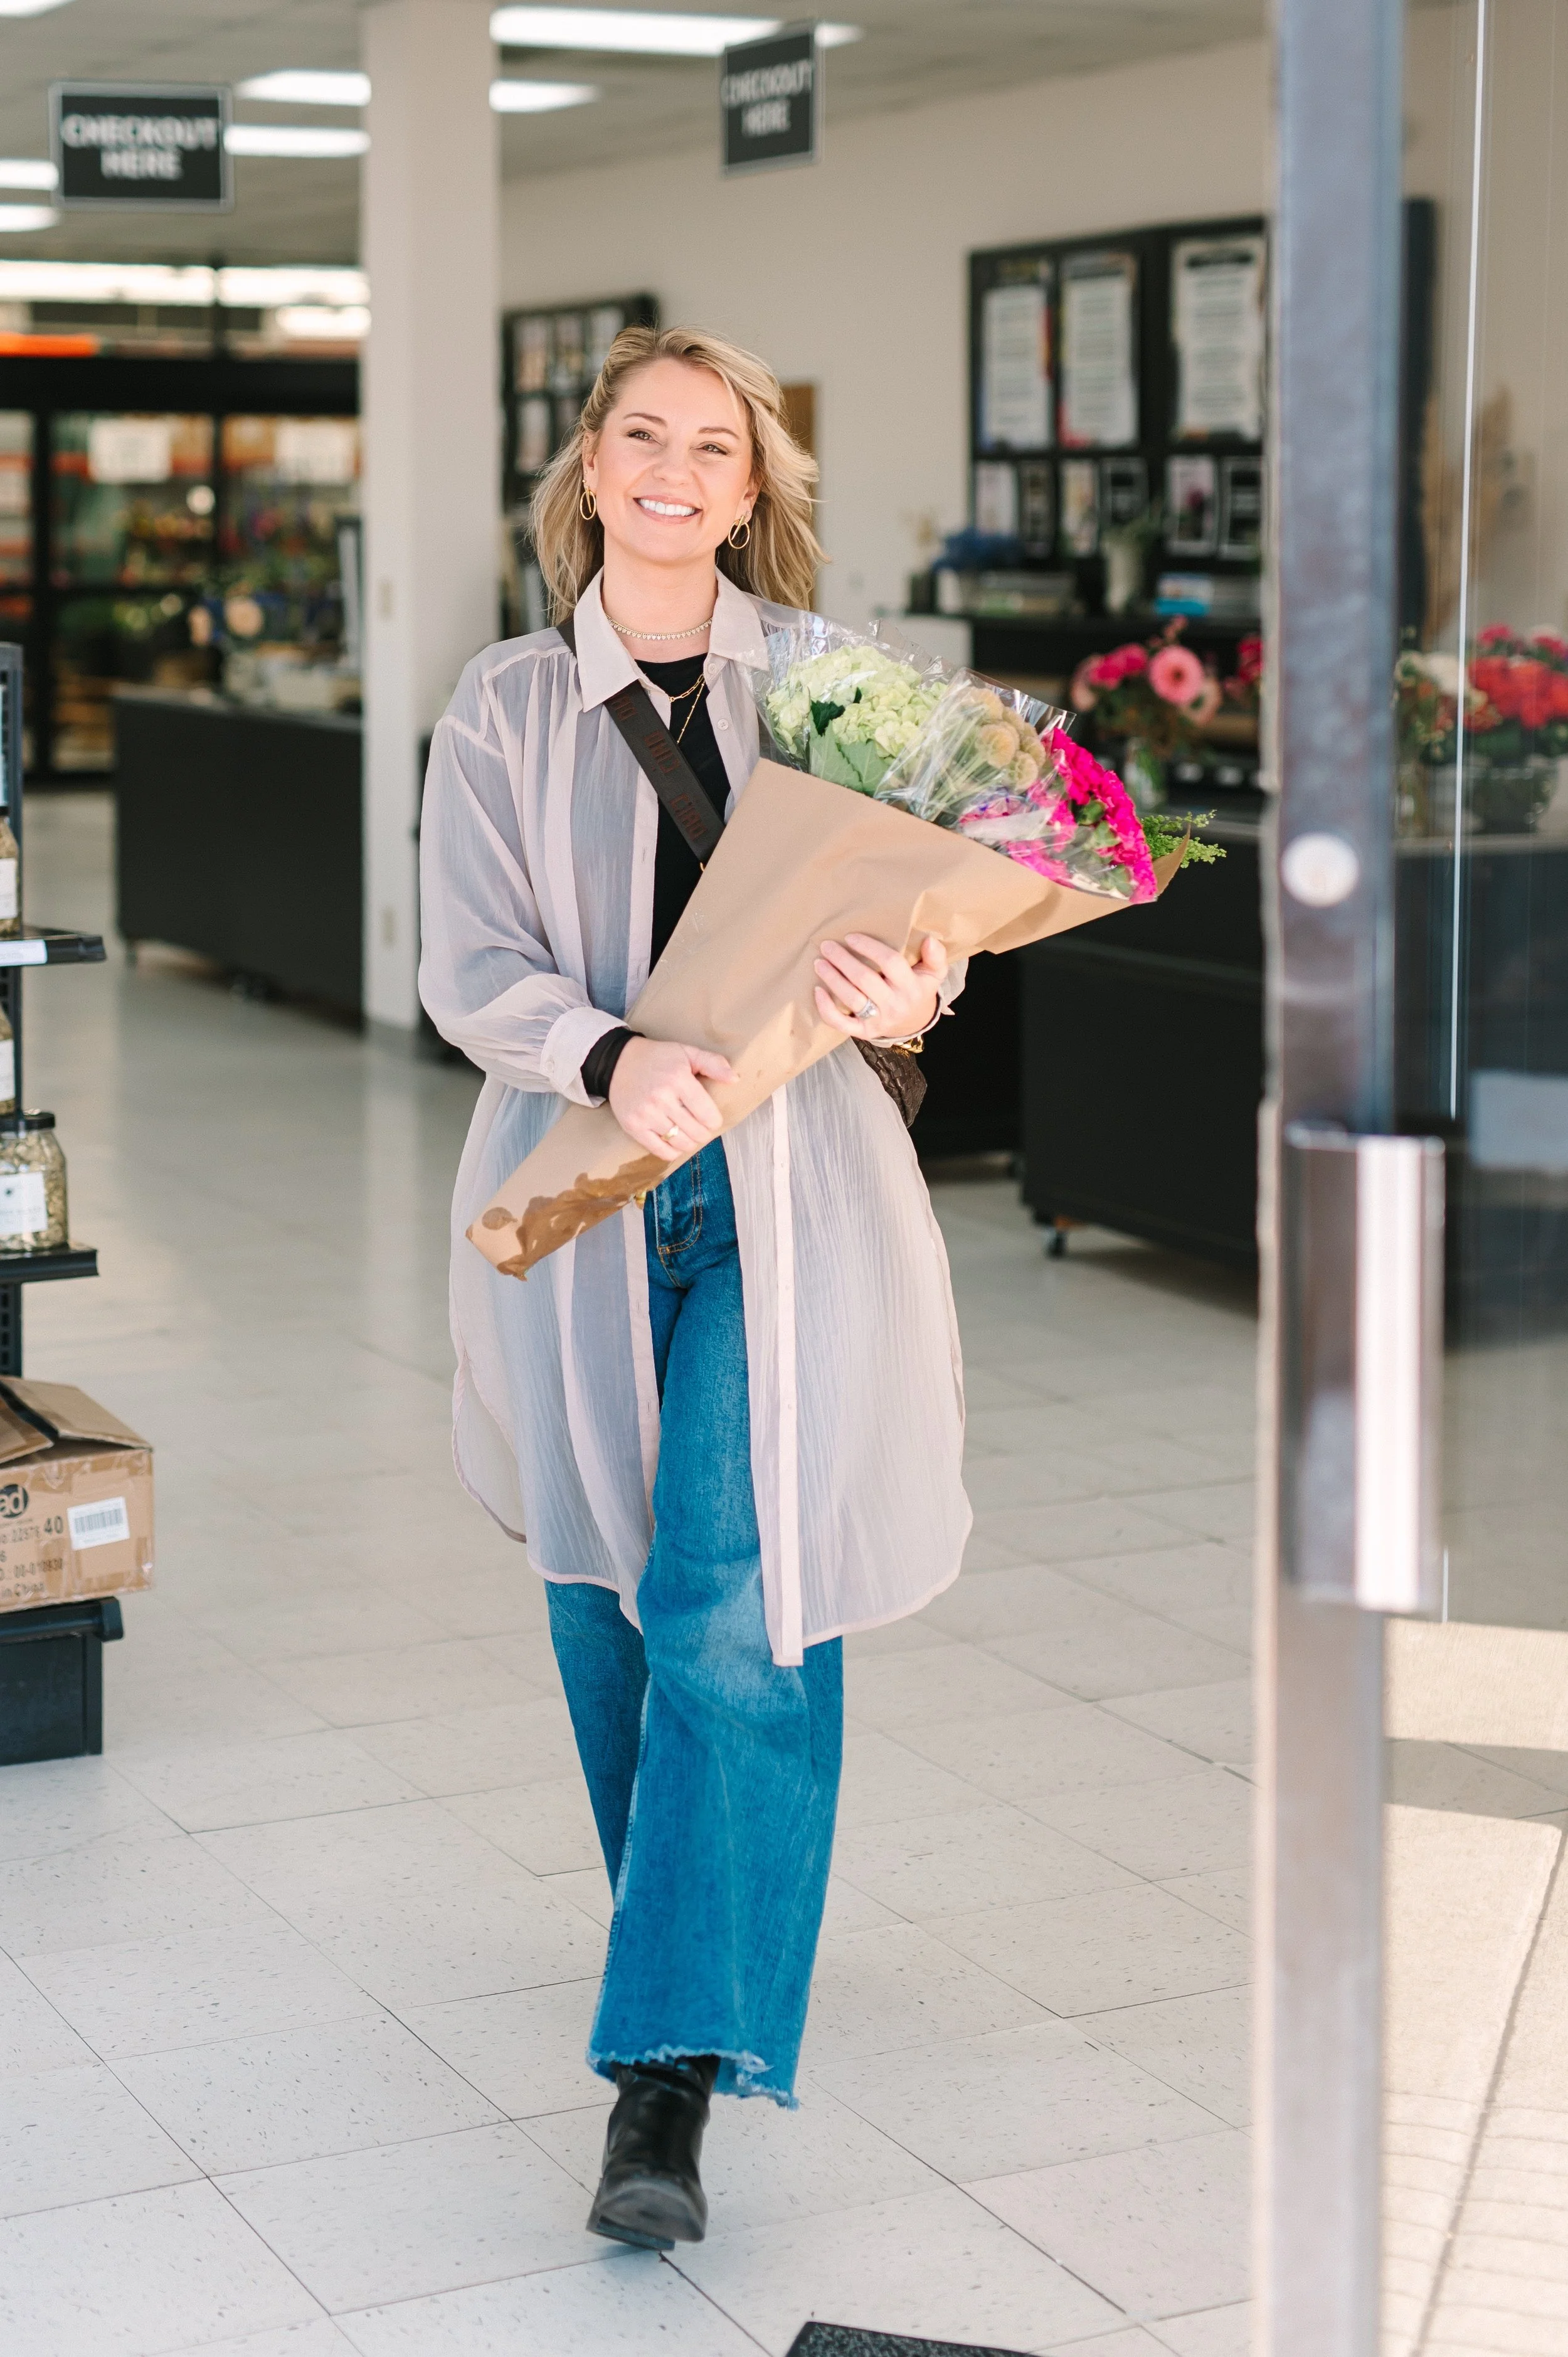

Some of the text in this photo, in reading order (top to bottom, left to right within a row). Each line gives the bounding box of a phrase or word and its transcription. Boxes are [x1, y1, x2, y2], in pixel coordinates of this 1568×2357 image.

[721, 60, 812, 106] CHECKOUT
[61, 114, 217, 149] CHECKOUT
[743, 98, 792, 137] HERE
[100, 151, 181, 179] HERE
[44, 1515, 63, 1535] 40
